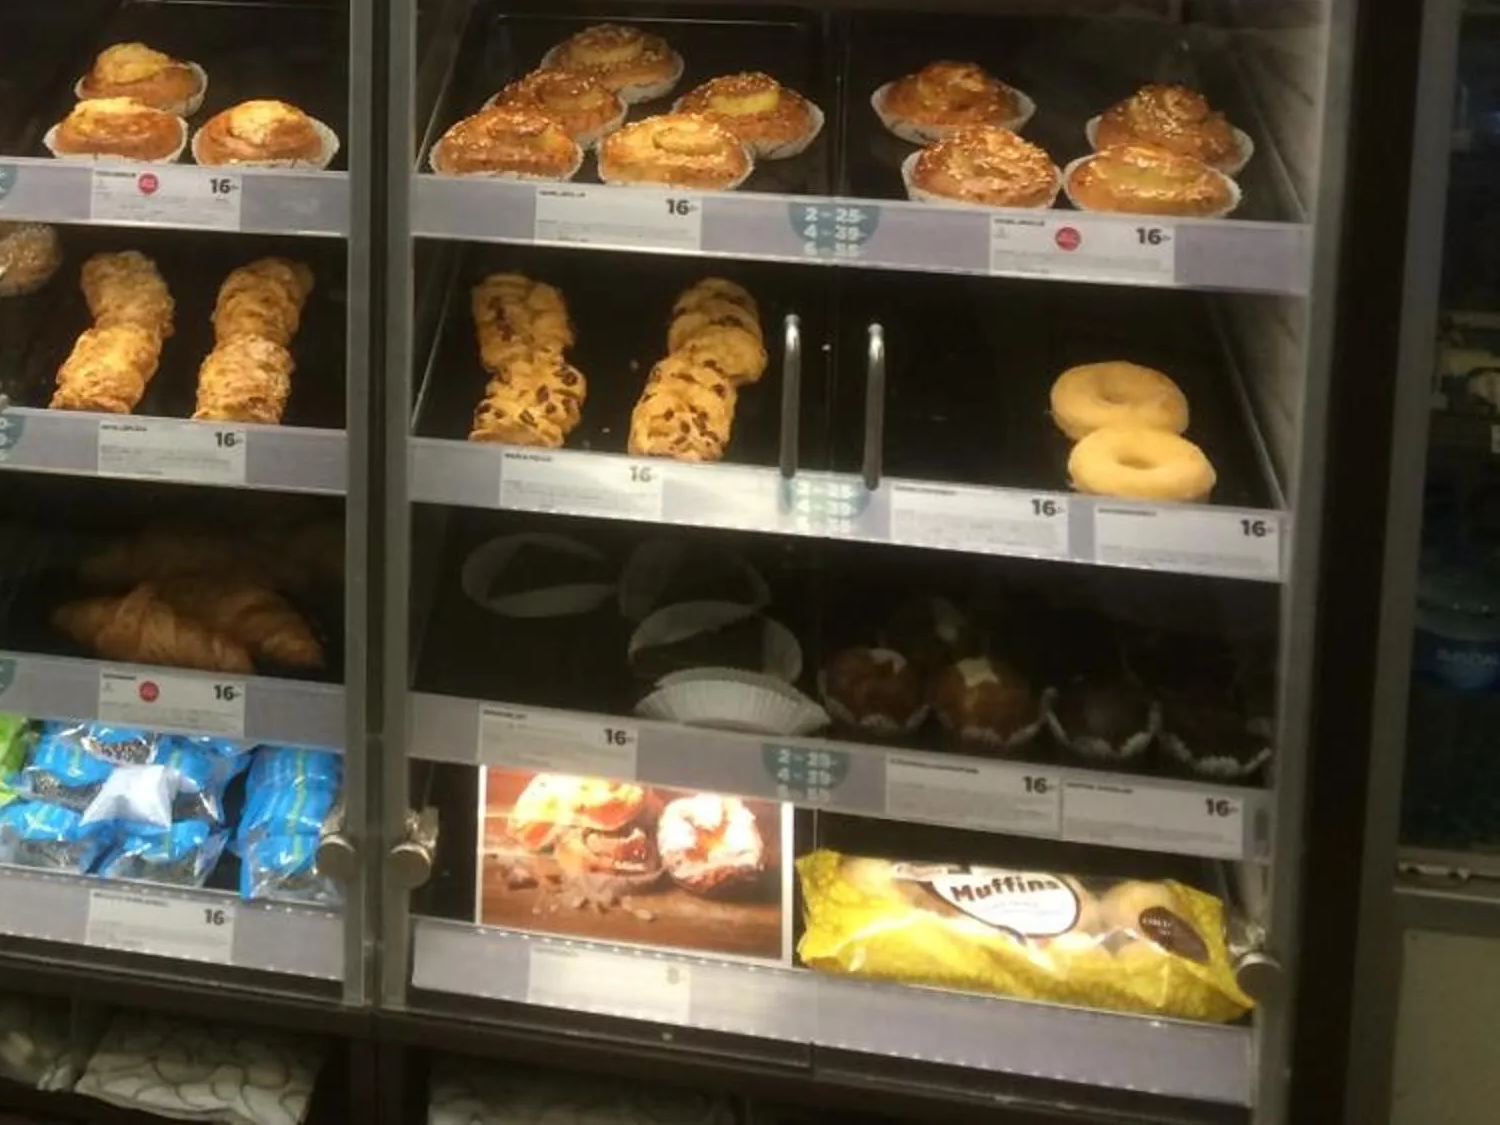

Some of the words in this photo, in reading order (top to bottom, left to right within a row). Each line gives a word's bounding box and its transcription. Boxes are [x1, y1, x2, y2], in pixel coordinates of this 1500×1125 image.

[805, 207, 818, 222] 2
[804, 223, 817, 238] 4
[950, 875, 1061, 902] Muffins
